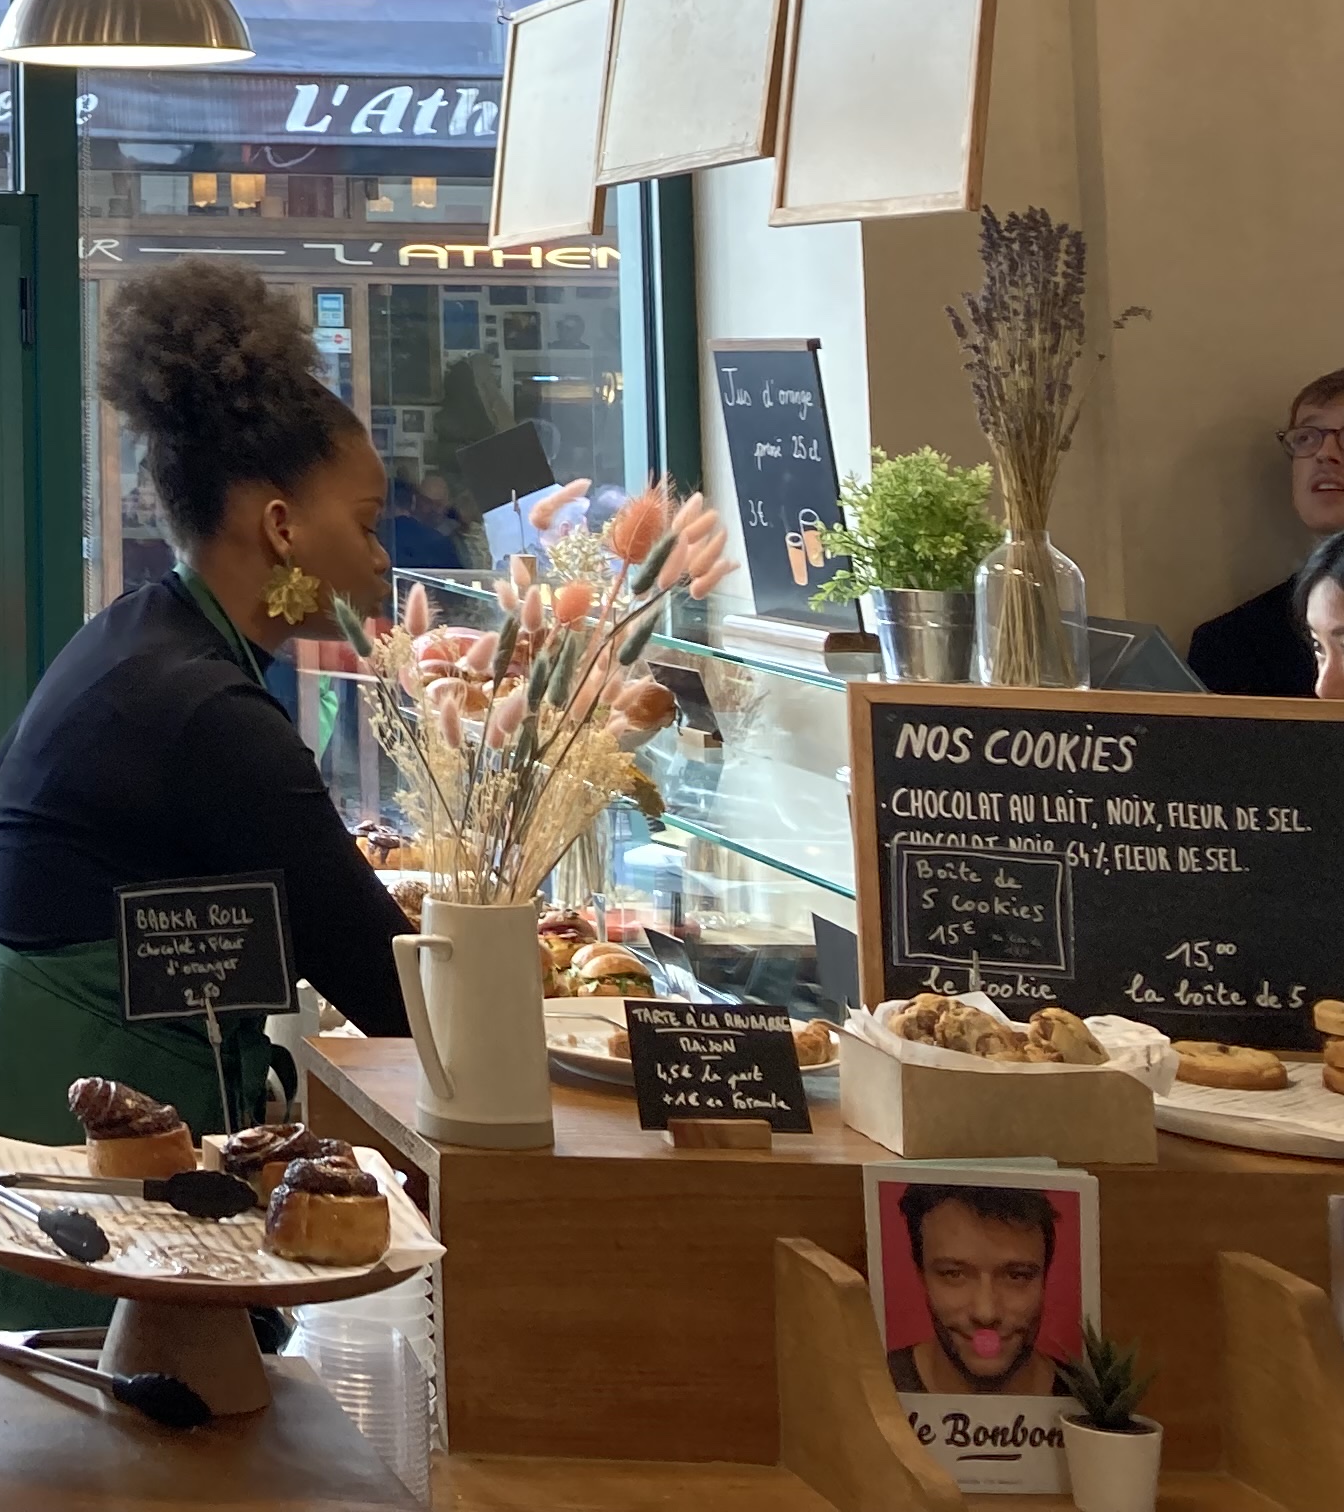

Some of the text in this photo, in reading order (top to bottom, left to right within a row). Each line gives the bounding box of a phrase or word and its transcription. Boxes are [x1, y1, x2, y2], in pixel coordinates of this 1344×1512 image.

[721, 367, 752, 407] Jus
[895, 723, 1137, 773] NOS COOKIES
[892, 788, 1004, 822] CHOCOLAT
[1009, 794, 1035, 824] AU
[1167, 802, 1228, 831] FLEUR
[1235, 806, 1261, 832] DE
[1114, 844, 1172, 872] FLEUR
[1177, 846, 1203, 873] DE
[916, 859, 1023, 889] Boîte de
[136, 904, 254, 931] BABKA ROLL
[928, 920, 976, 945] 15€
[922, 966, 958, 995] le
[1125, 973, 1306, 1008] la boîte de 5
[632, 1007, 681, 1027] TARTE
[701, 1012, 720, 1028] LA
[656, 1062, 693, 1085] 4,5€
[942, 1412, 1066, 1449] Bonbon
